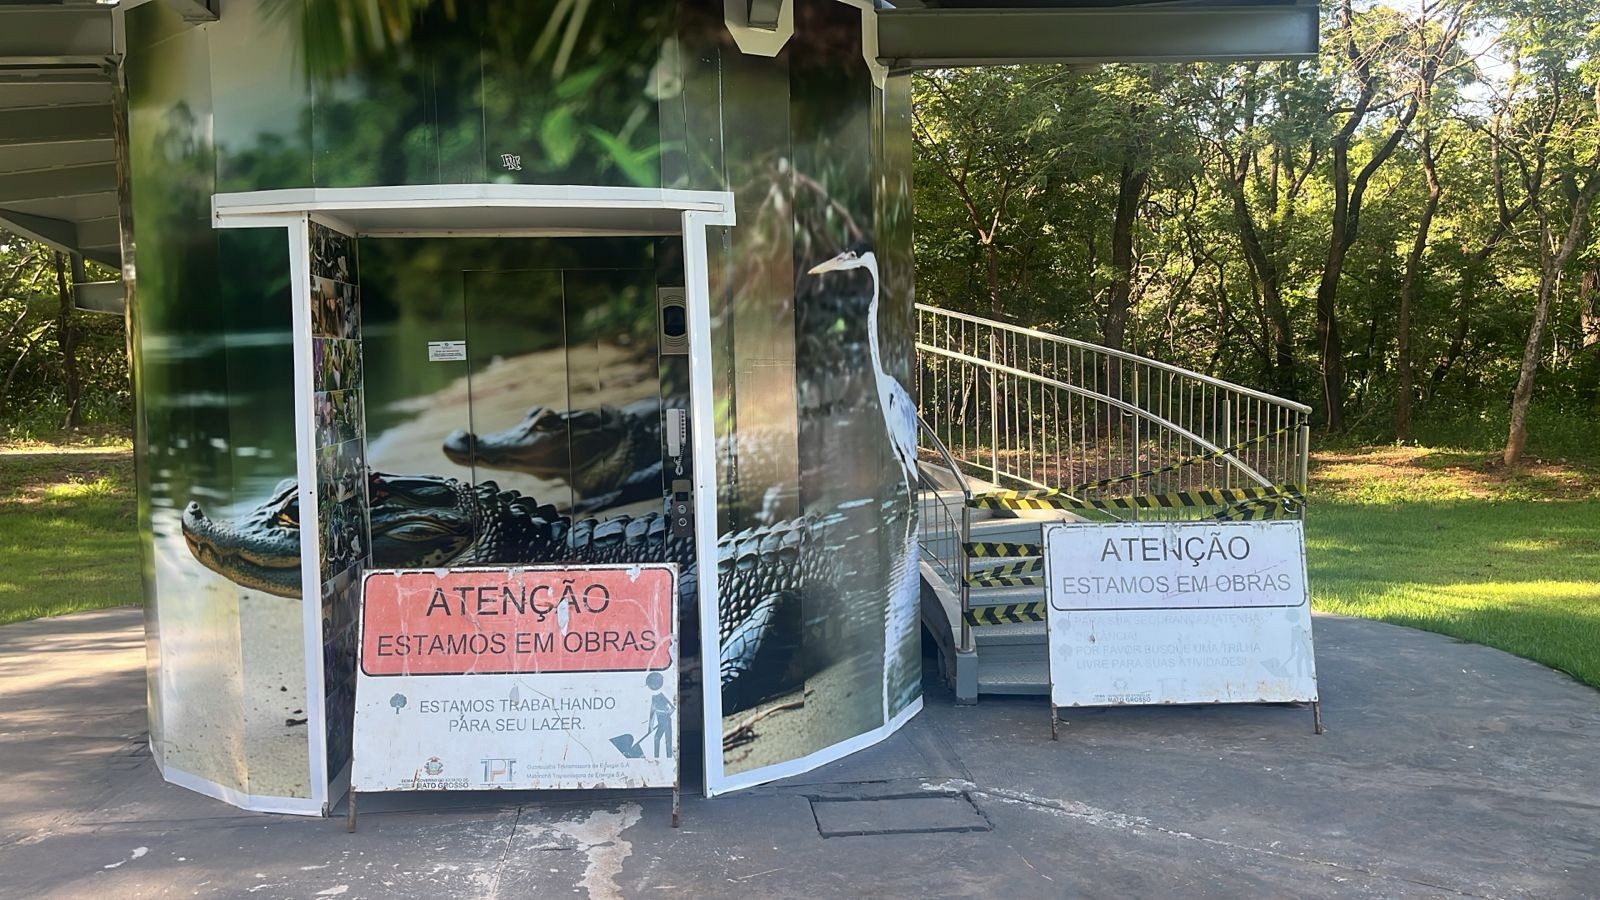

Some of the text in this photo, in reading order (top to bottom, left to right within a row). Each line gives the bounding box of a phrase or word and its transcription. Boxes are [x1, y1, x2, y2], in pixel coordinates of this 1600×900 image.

[1100, 532, 1250, 567] ATENÇÃO
[1062, 573, 1292, 595] ESTAMOS EM OBRAS
[426, 578, 611, 622] ATENÇÃO
[377, 629, 657, 657] ESTAMOS EM OBRAS
[420, 696, 617, 713] ESTAMOS TRABALHANDO
[448, 716, 586, 733] PARA SEU LAZER.
